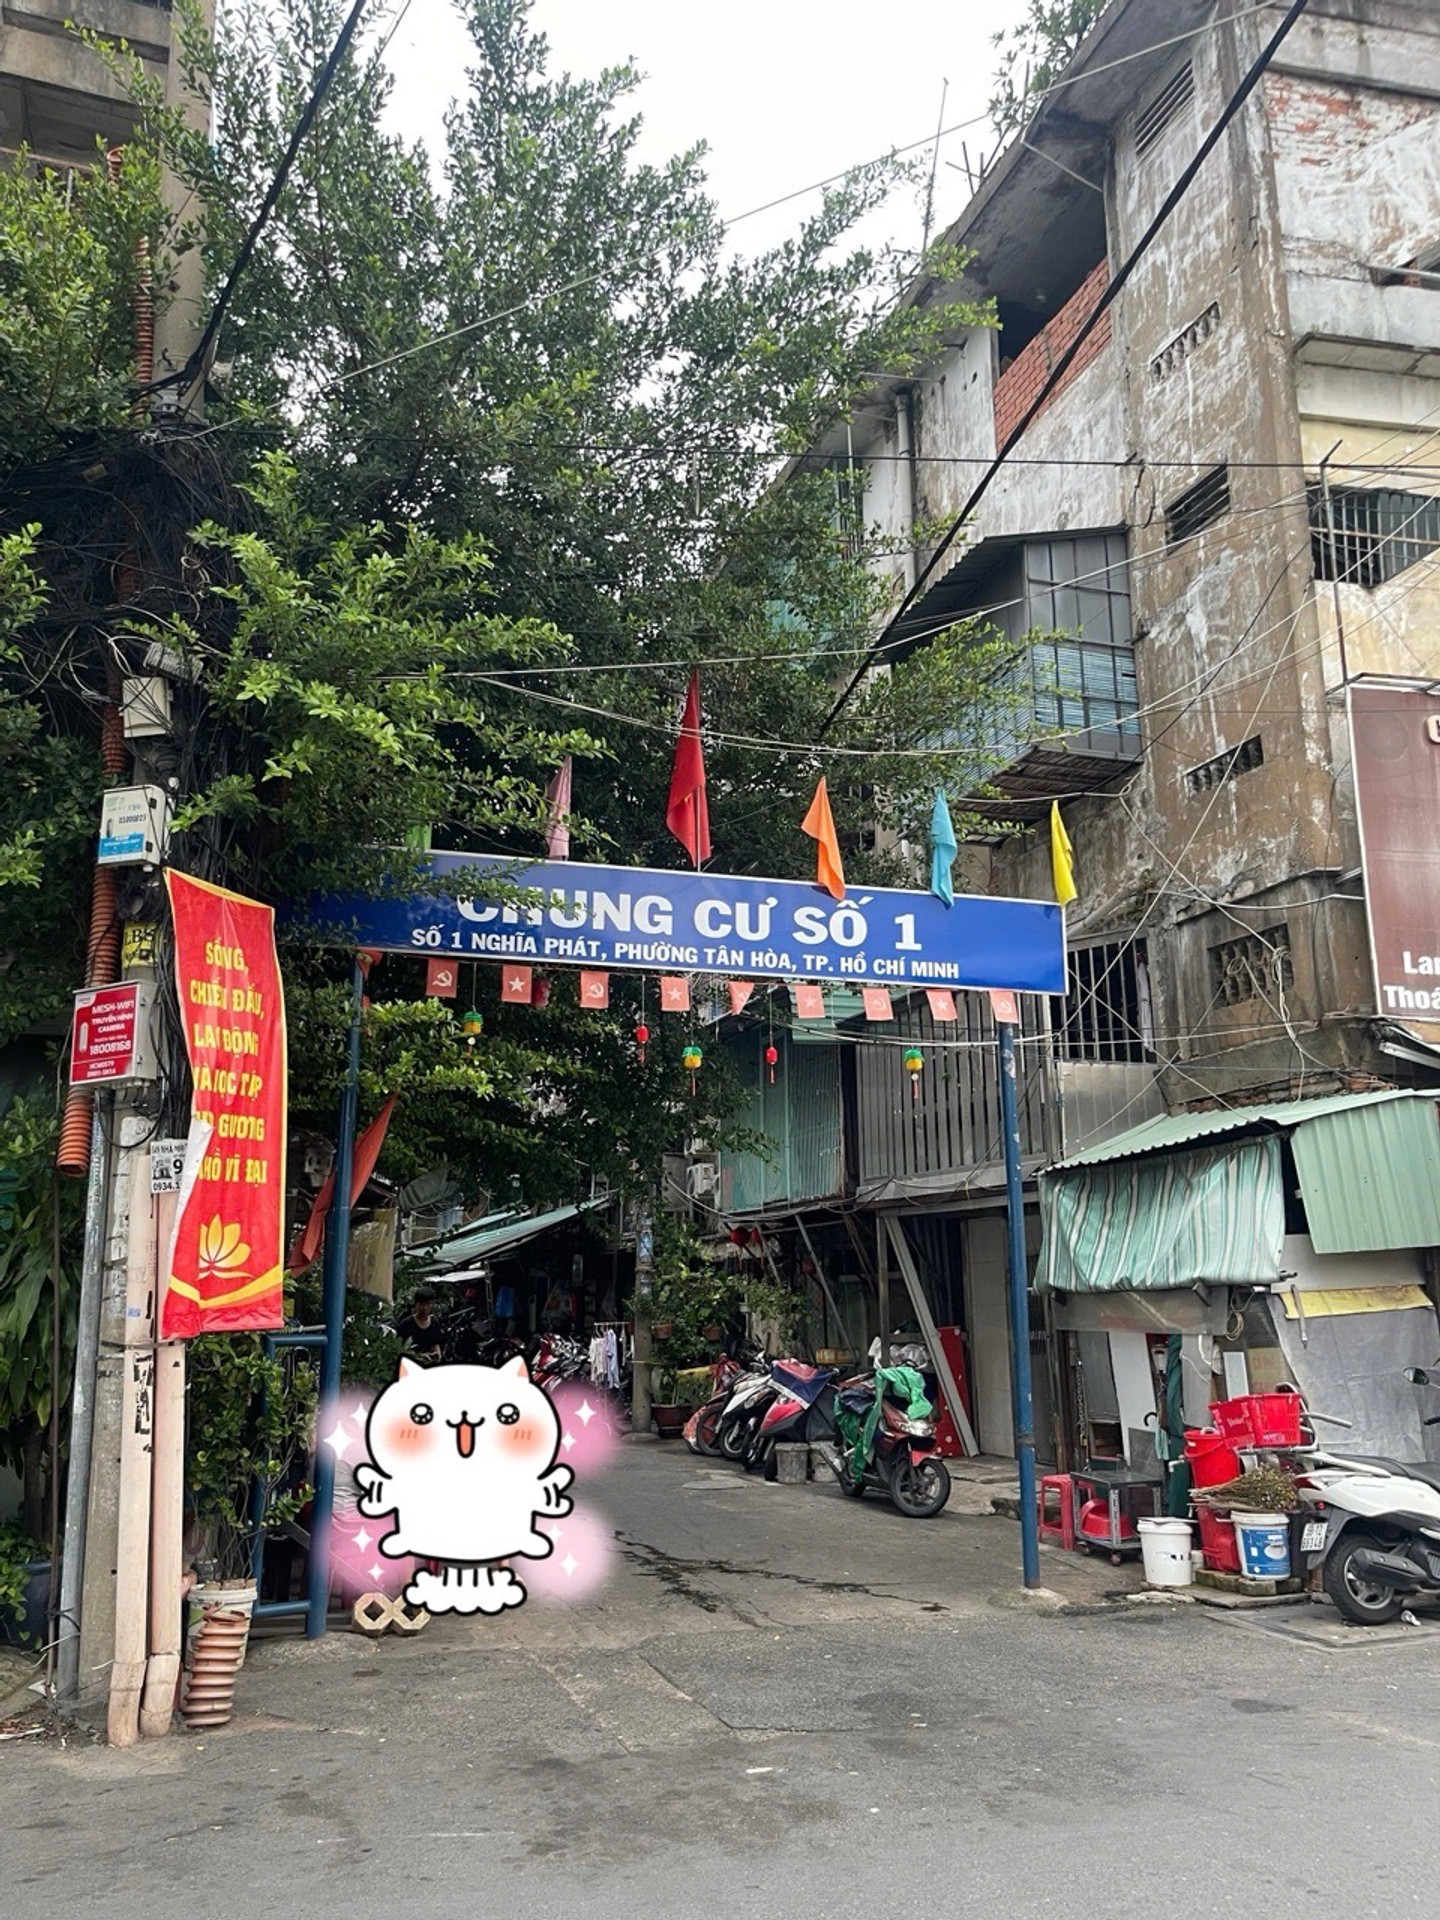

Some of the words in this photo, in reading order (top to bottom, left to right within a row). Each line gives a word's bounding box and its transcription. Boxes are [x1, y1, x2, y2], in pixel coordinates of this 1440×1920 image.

[457, 886, 673, 936] CHUNG
[694, 896, 778, 942] CƯ
[791, 895, 874, 947] SỐ
[894, 913, 922, 950] 1
[411, 923, 444, 947] SỐ
[451, 932, 463, 948] 1
[471, 931, 537, 954] NGHĨA
[544, 936, 607, 961] PHÁT,
[615, 941, 698, 963] PHƯỜNG
[704, 946, 744, 966] TÂN
[751, 948, 797, 972] HÒA,
[803, 954, 834, 972] TP.
[840, 951, 867, 973] HỒ
[873, 956, 905, 976] CHÍ
[911, 960, 959, 979] MINH
[91, 1000, 135, 1014] MESH-WIFI
[232, 983, 264, 1020] ĐẤU,
[98, 1023, 126, 1033] CAMERA
[194, 1023, 220, 1049] LA
